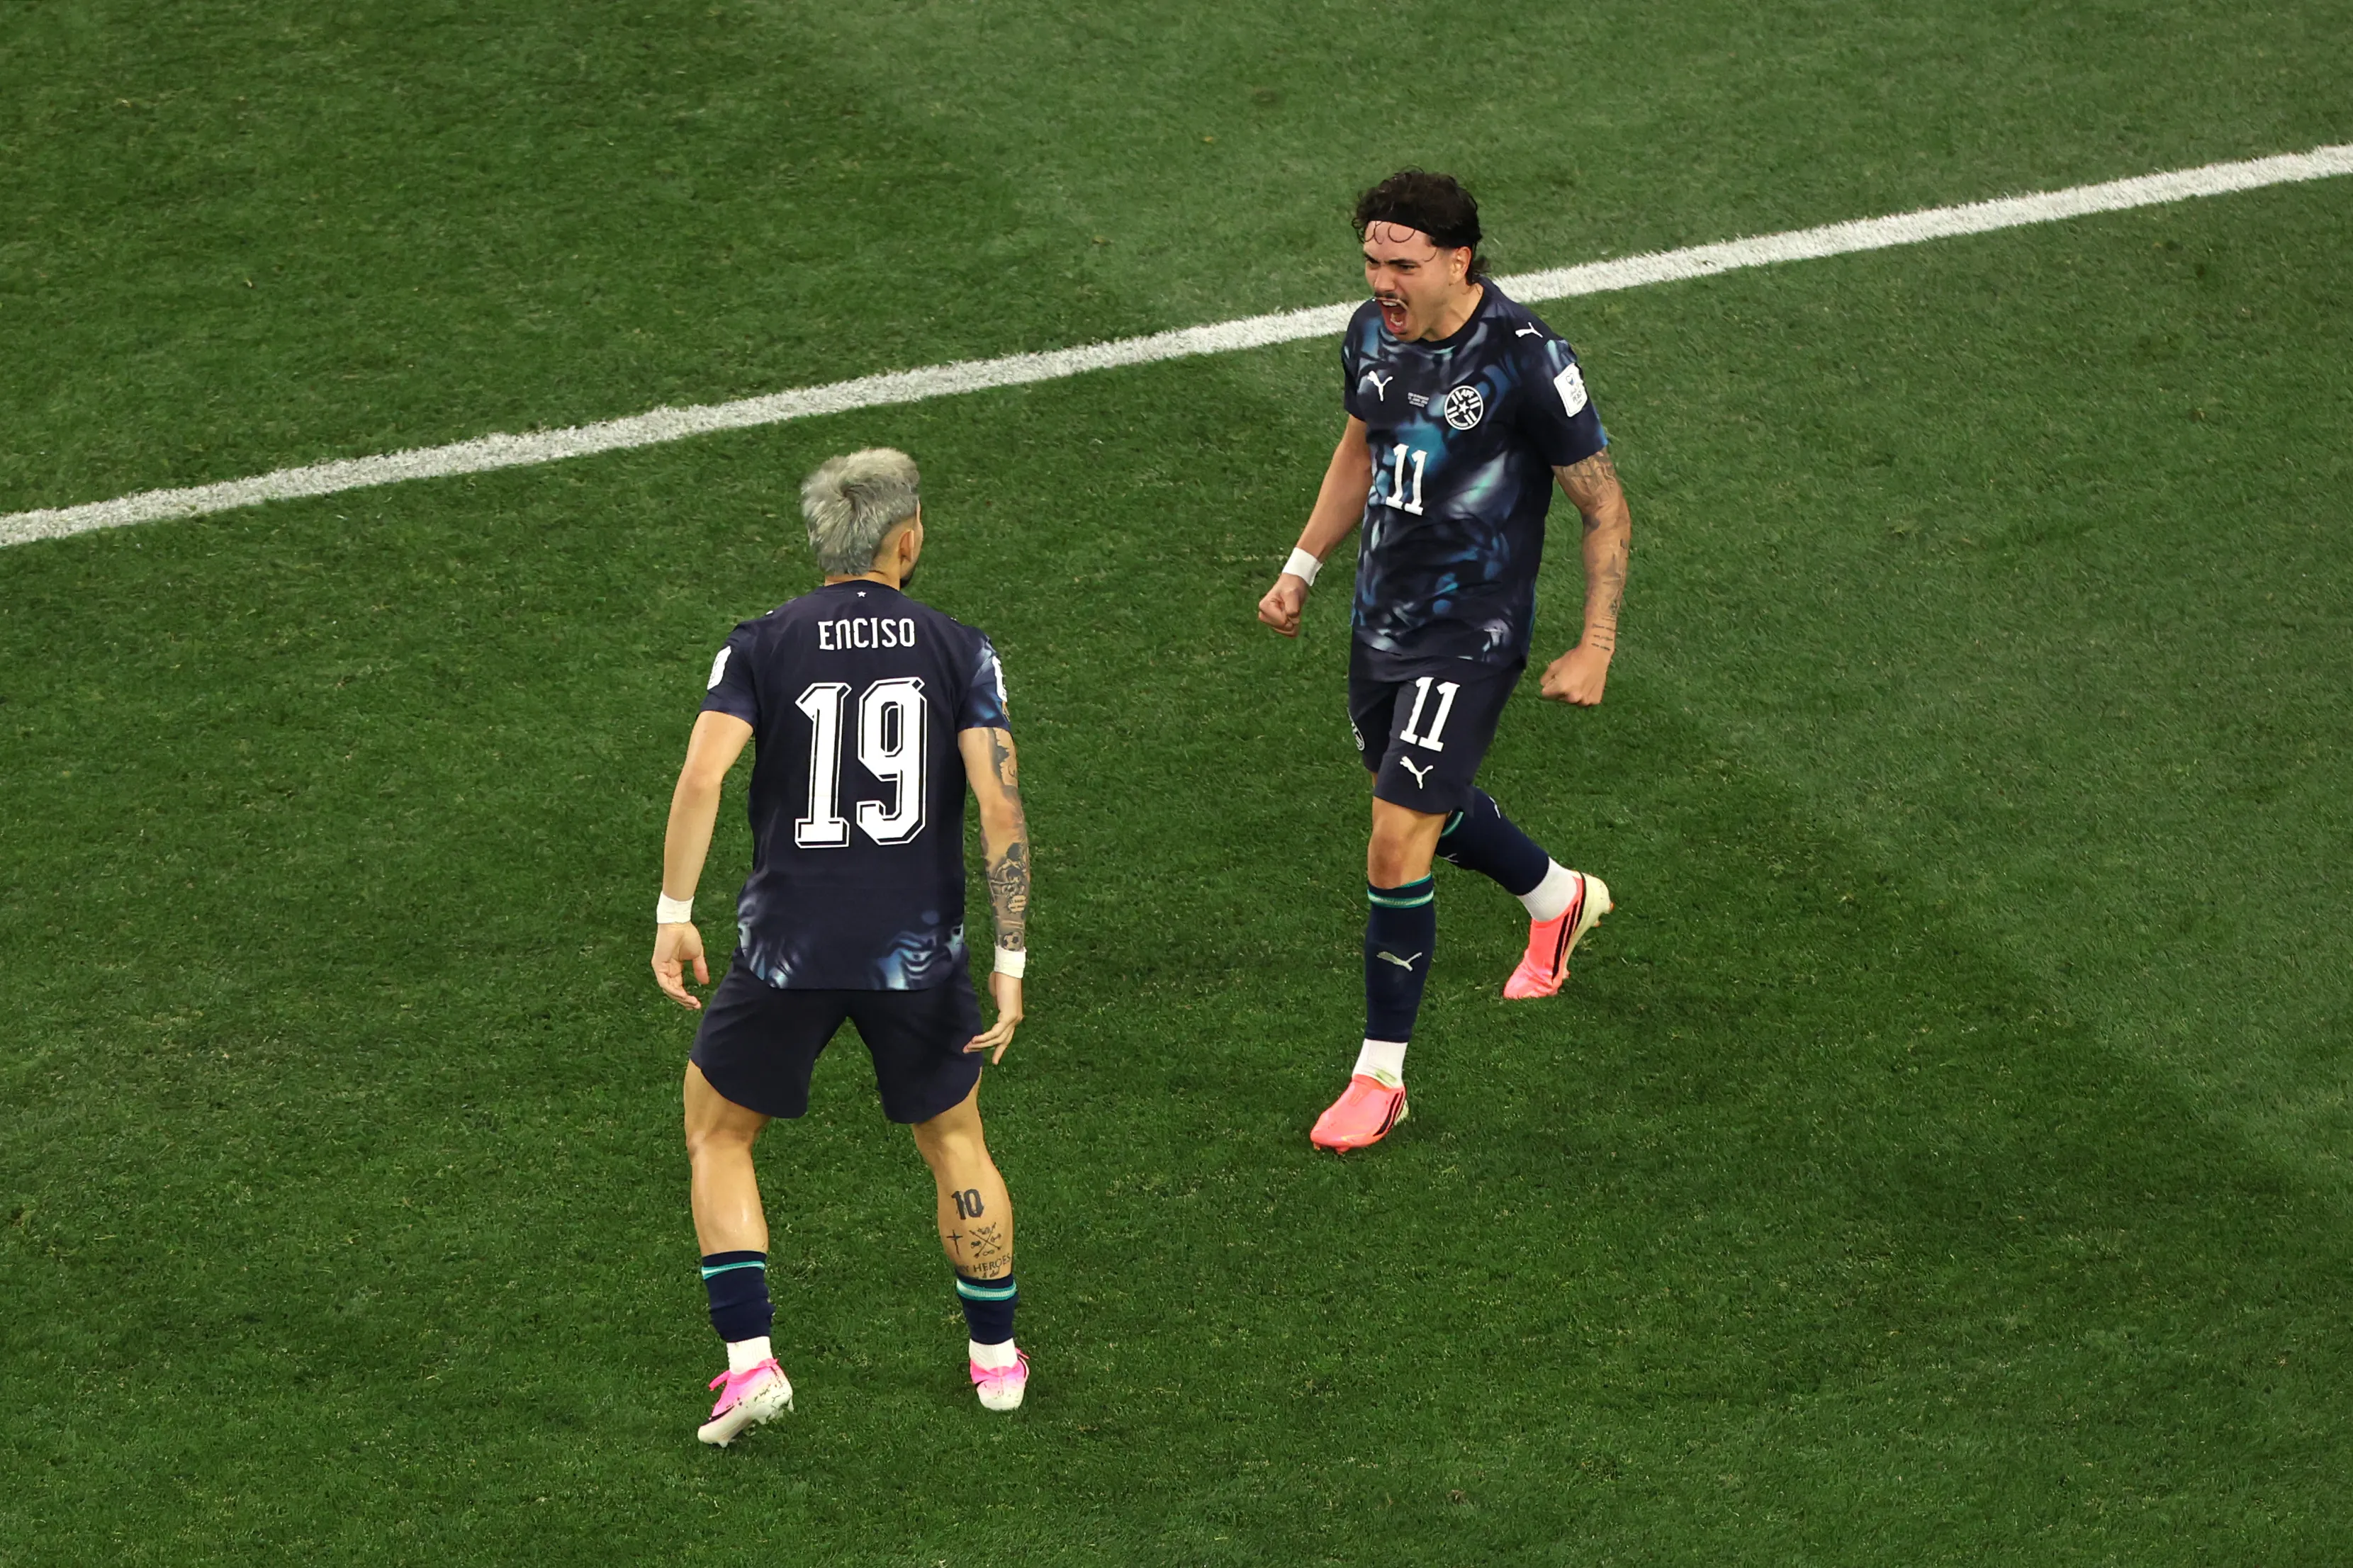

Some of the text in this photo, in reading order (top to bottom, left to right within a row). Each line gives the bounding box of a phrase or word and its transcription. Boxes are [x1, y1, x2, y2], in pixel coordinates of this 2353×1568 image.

[1460, 388, 1476, 398] APF
[1386, 443, 1428, 516] 11
[818, 618, 916, 650] ENCISO
[1400, 676, 1461, 752] 11
[794, 676, 928, 849] 19
[950, 1188, 984, 1220] 10
[973, 1253, 1011, 1273] HEROES
